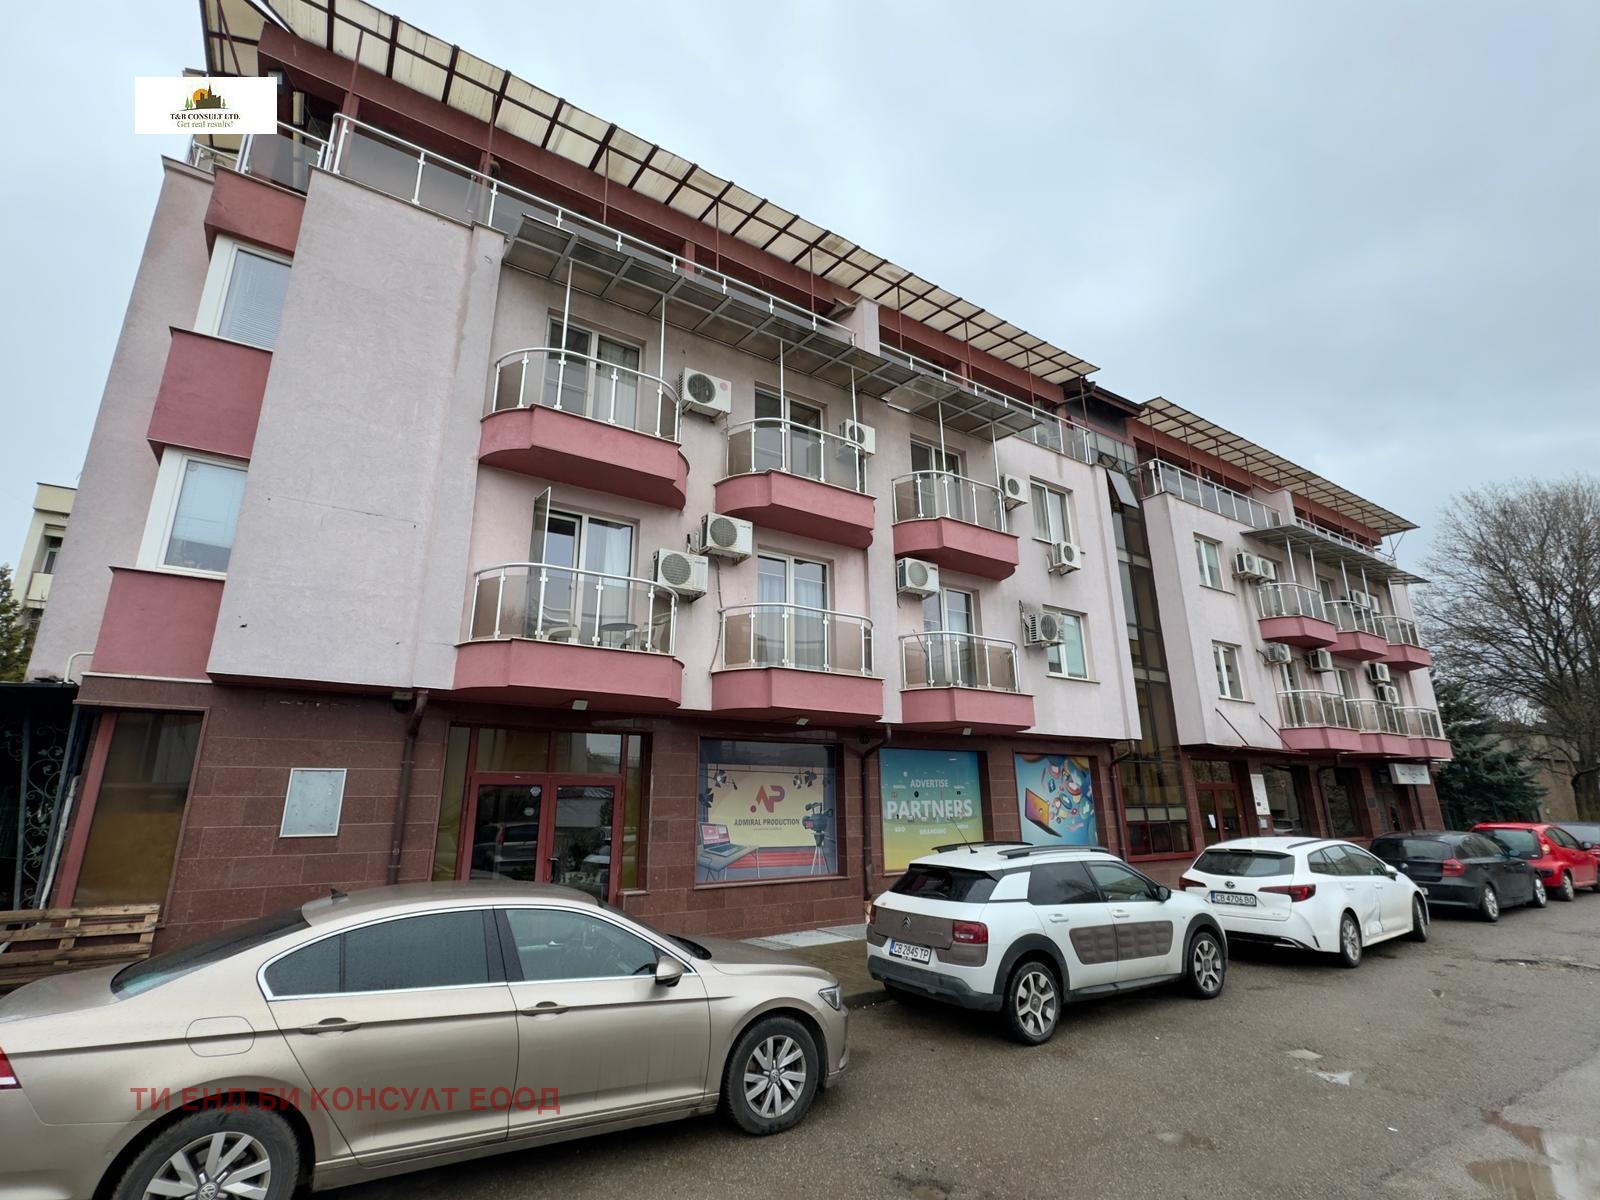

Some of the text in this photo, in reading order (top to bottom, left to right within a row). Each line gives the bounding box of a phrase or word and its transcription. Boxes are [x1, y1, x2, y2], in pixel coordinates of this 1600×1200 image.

[910, 779, 949, 789] ADVERTISE
[886, 799, 973, 820] PARTNERS
[734, 818, 800, 826] ADMIRAL PRODUCTION
[1216, 894, 1226, 902] CB
[1226, 894, 1244, 903] 4706
[894, 943, 903, 954] CB
[903, 945, 919, 957] 2845
[920, 949, 930, 960] TP
